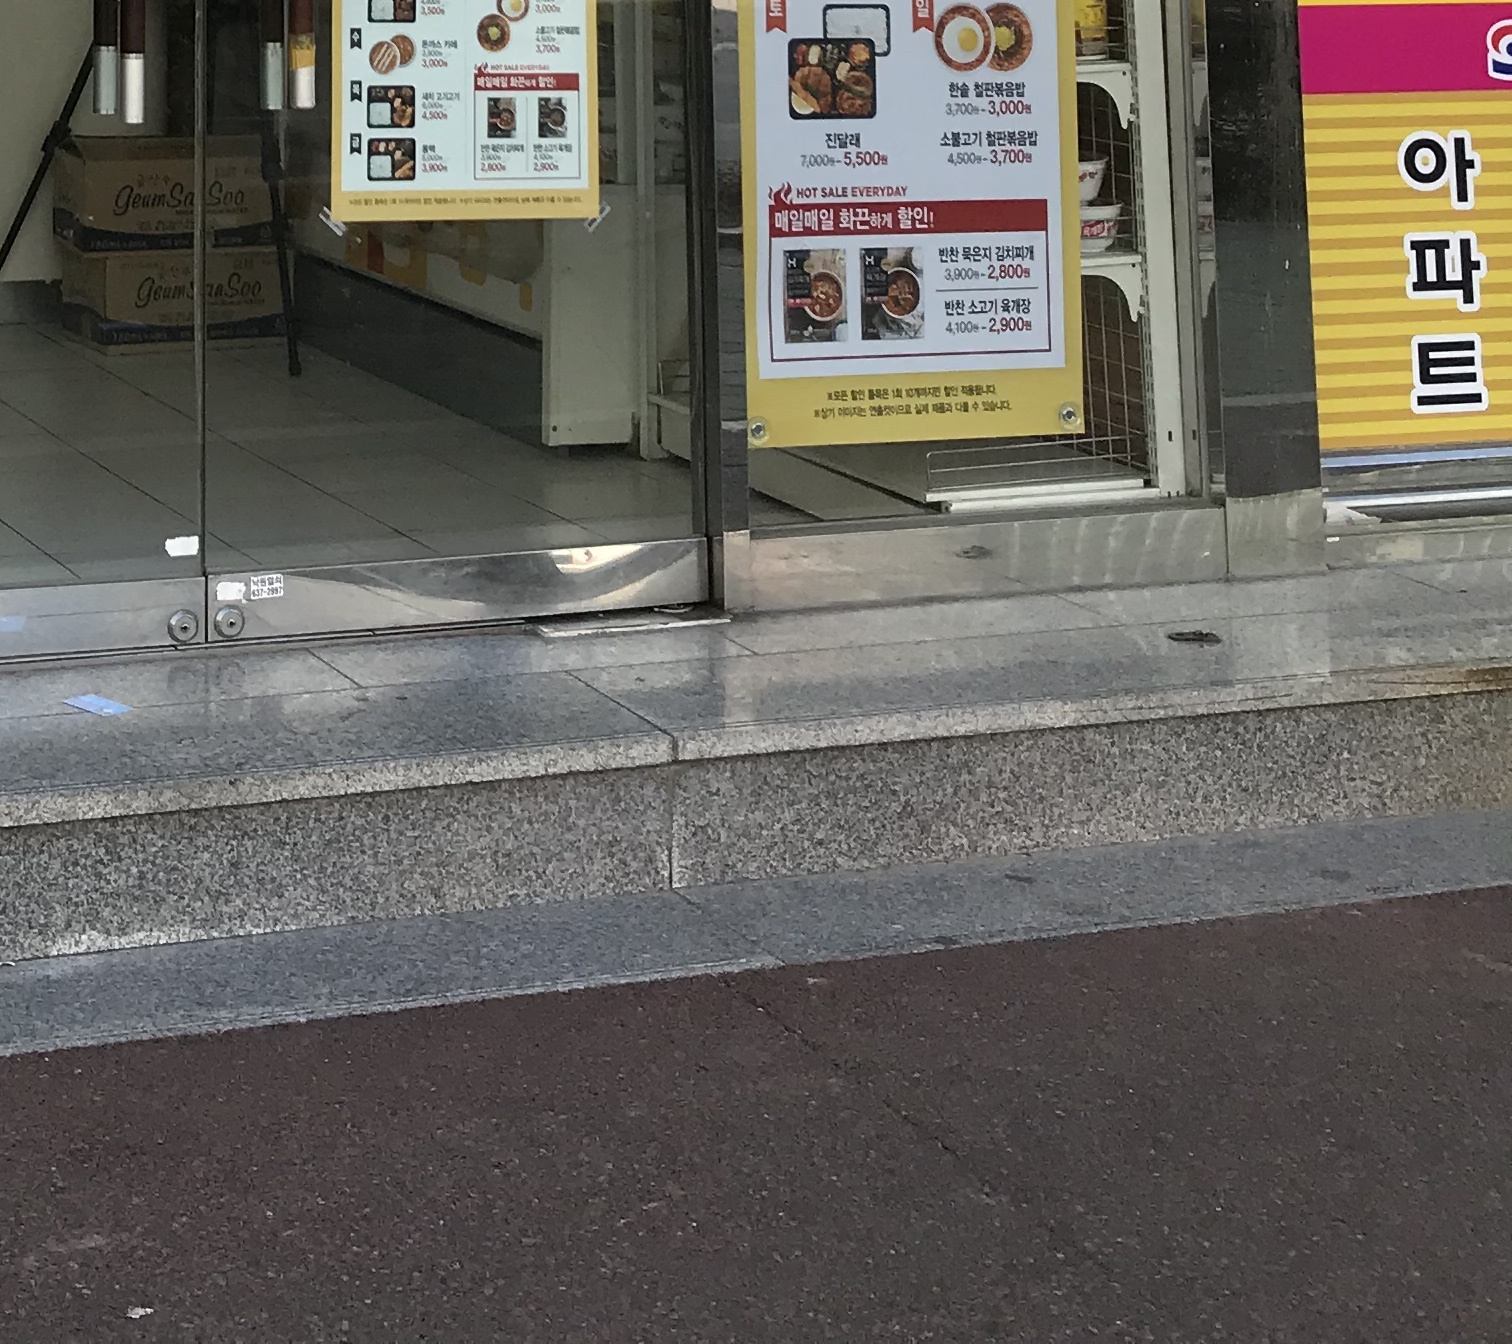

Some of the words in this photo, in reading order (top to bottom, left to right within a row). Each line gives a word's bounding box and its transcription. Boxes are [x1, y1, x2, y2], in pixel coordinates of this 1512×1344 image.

[769, 0, 782, 18] 토
[948, 81, 970, 98] 한솥
[973, 81, 1026, 98] 철판볶음밥
[988, 99, 1032, 116] 3,000원
[824, 132, 861, 149] 진달래
[940, 131, 982, 148] 소불고기
[985, 130, 1038, 147] 철판볶음밥
[843, 150, 888, 167] 5,500원
[989, 148, 1032, 165] 3,700원
[113, 181, 245, 216] GeumSaSoo
[796, 187, 818, 198] HOT
[822, 186, 848, 198] SALE
[851, 185, 908, 198] EVERYDAY
[774, 209, 835, 231] 매일매일
[839, 209, 893, 231] 화끈하게
[897, 208, 935, 229] 할인!
[938, 247, 959, 263] 반찬
[962, 246, 992, 262] 묵은지
[988, 264, 1030, 281] 2,800원
[945, 300, 965, 316] 반찬
[968, 299, 998, 314] 소고기
[1001, 298, 1031, 314] 육개장
[989, 317, 1032, 334] 2,900원
